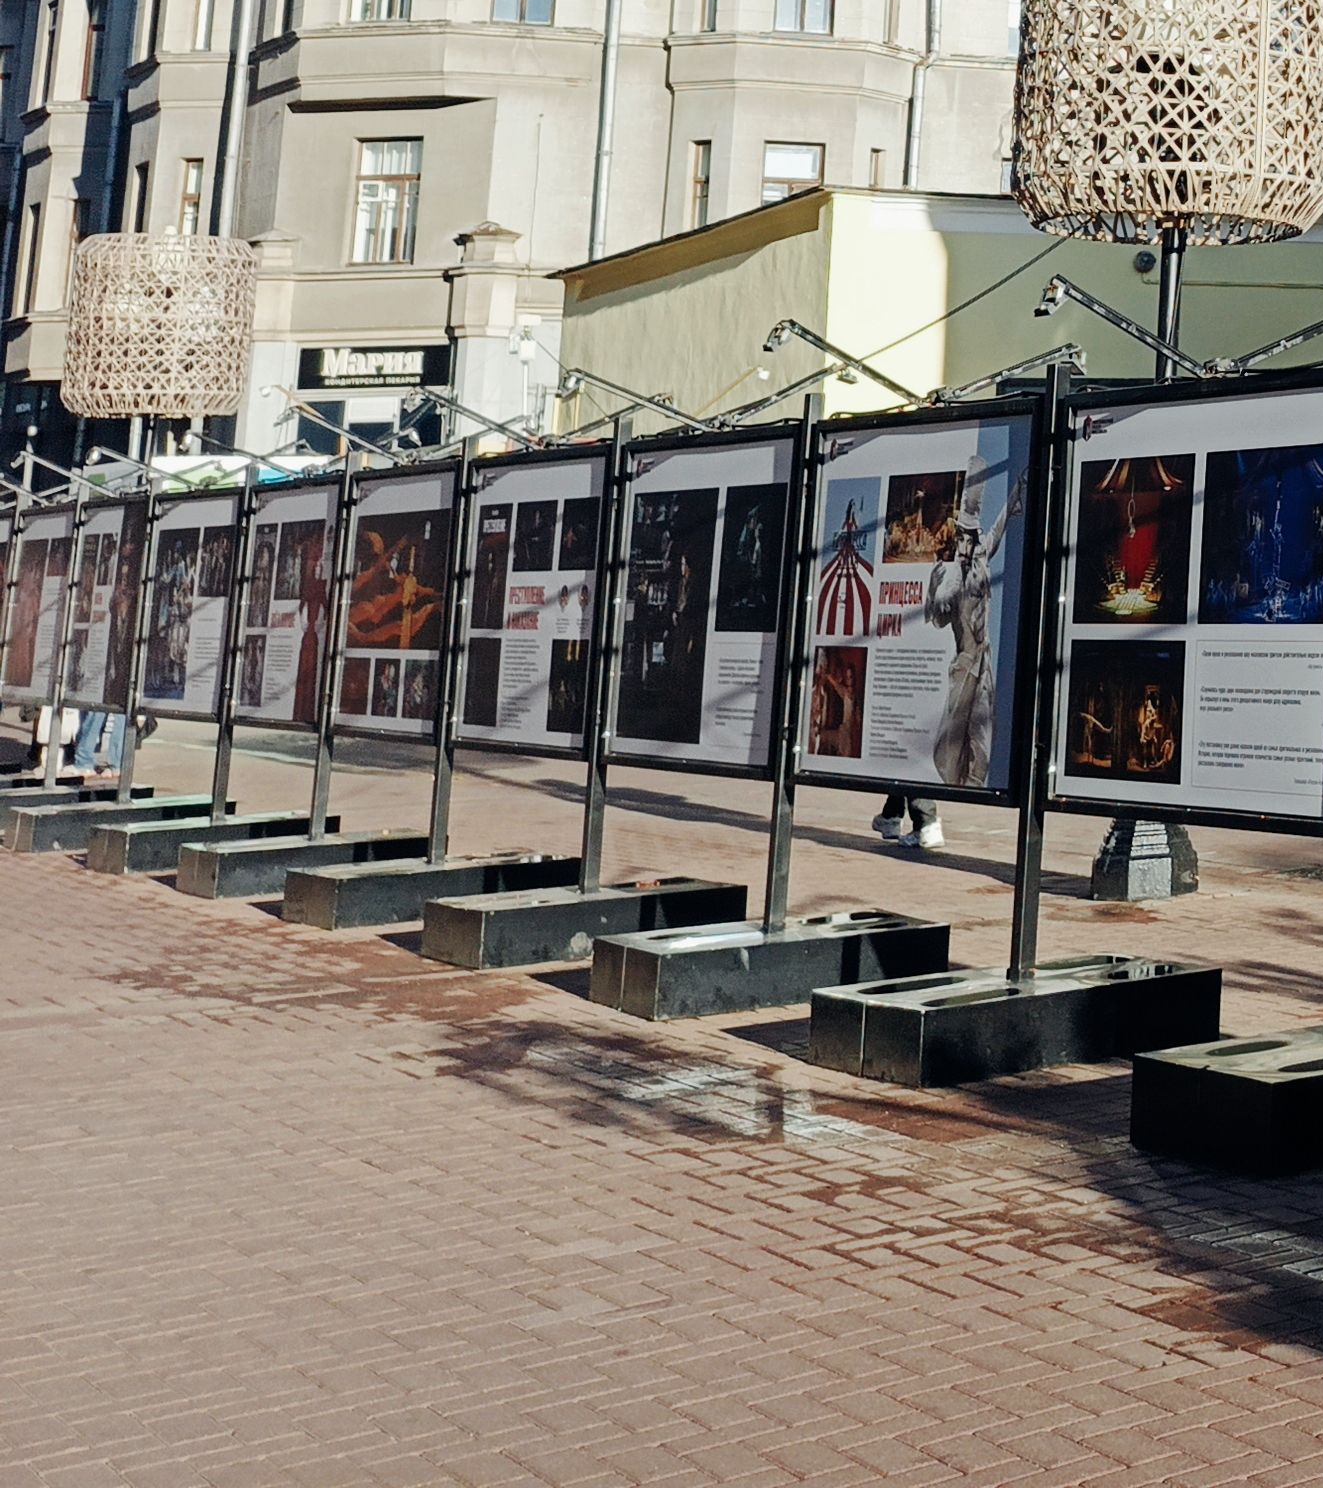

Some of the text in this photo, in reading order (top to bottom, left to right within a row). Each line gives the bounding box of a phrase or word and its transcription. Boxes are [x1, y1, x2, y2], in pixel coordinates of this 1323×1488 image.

[321, 348, 424, 377] Мария
[879, 581, 923, 608] ПРИНЦЕССА
[876, 613, 902, 639] ЦИРКА
